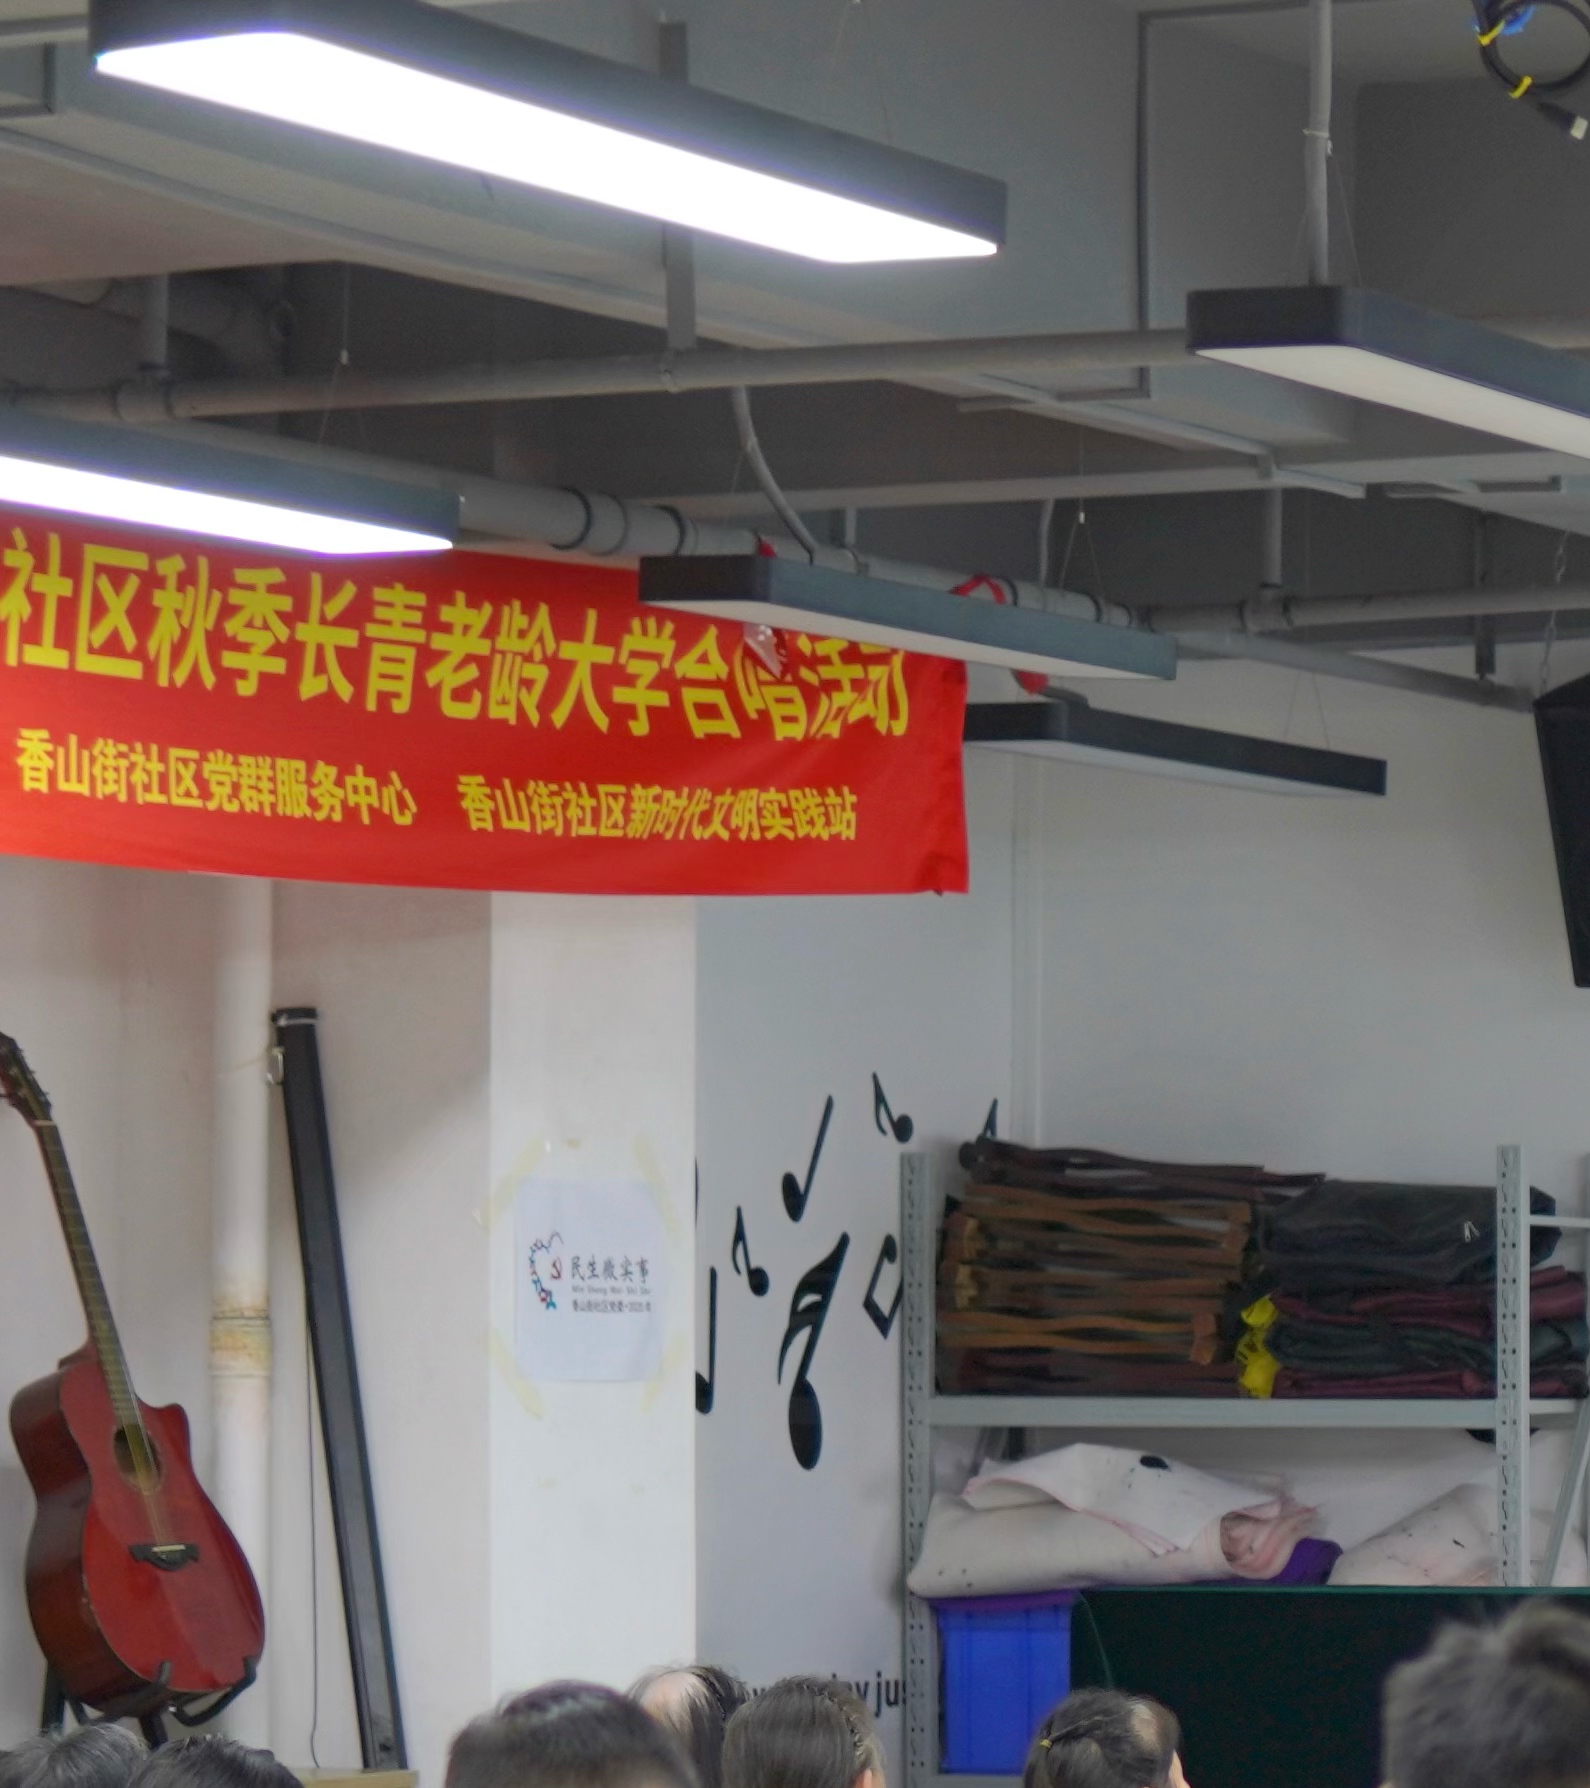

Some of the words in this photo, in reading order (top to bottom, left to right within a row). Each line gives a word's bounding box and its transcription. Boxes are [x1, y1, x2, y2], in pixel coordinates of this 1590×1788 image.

[15, 727, 419, 828] 香山街社区党群服务中心
[457, 774, 859, 842] 香山街社区新时代文明实践站
